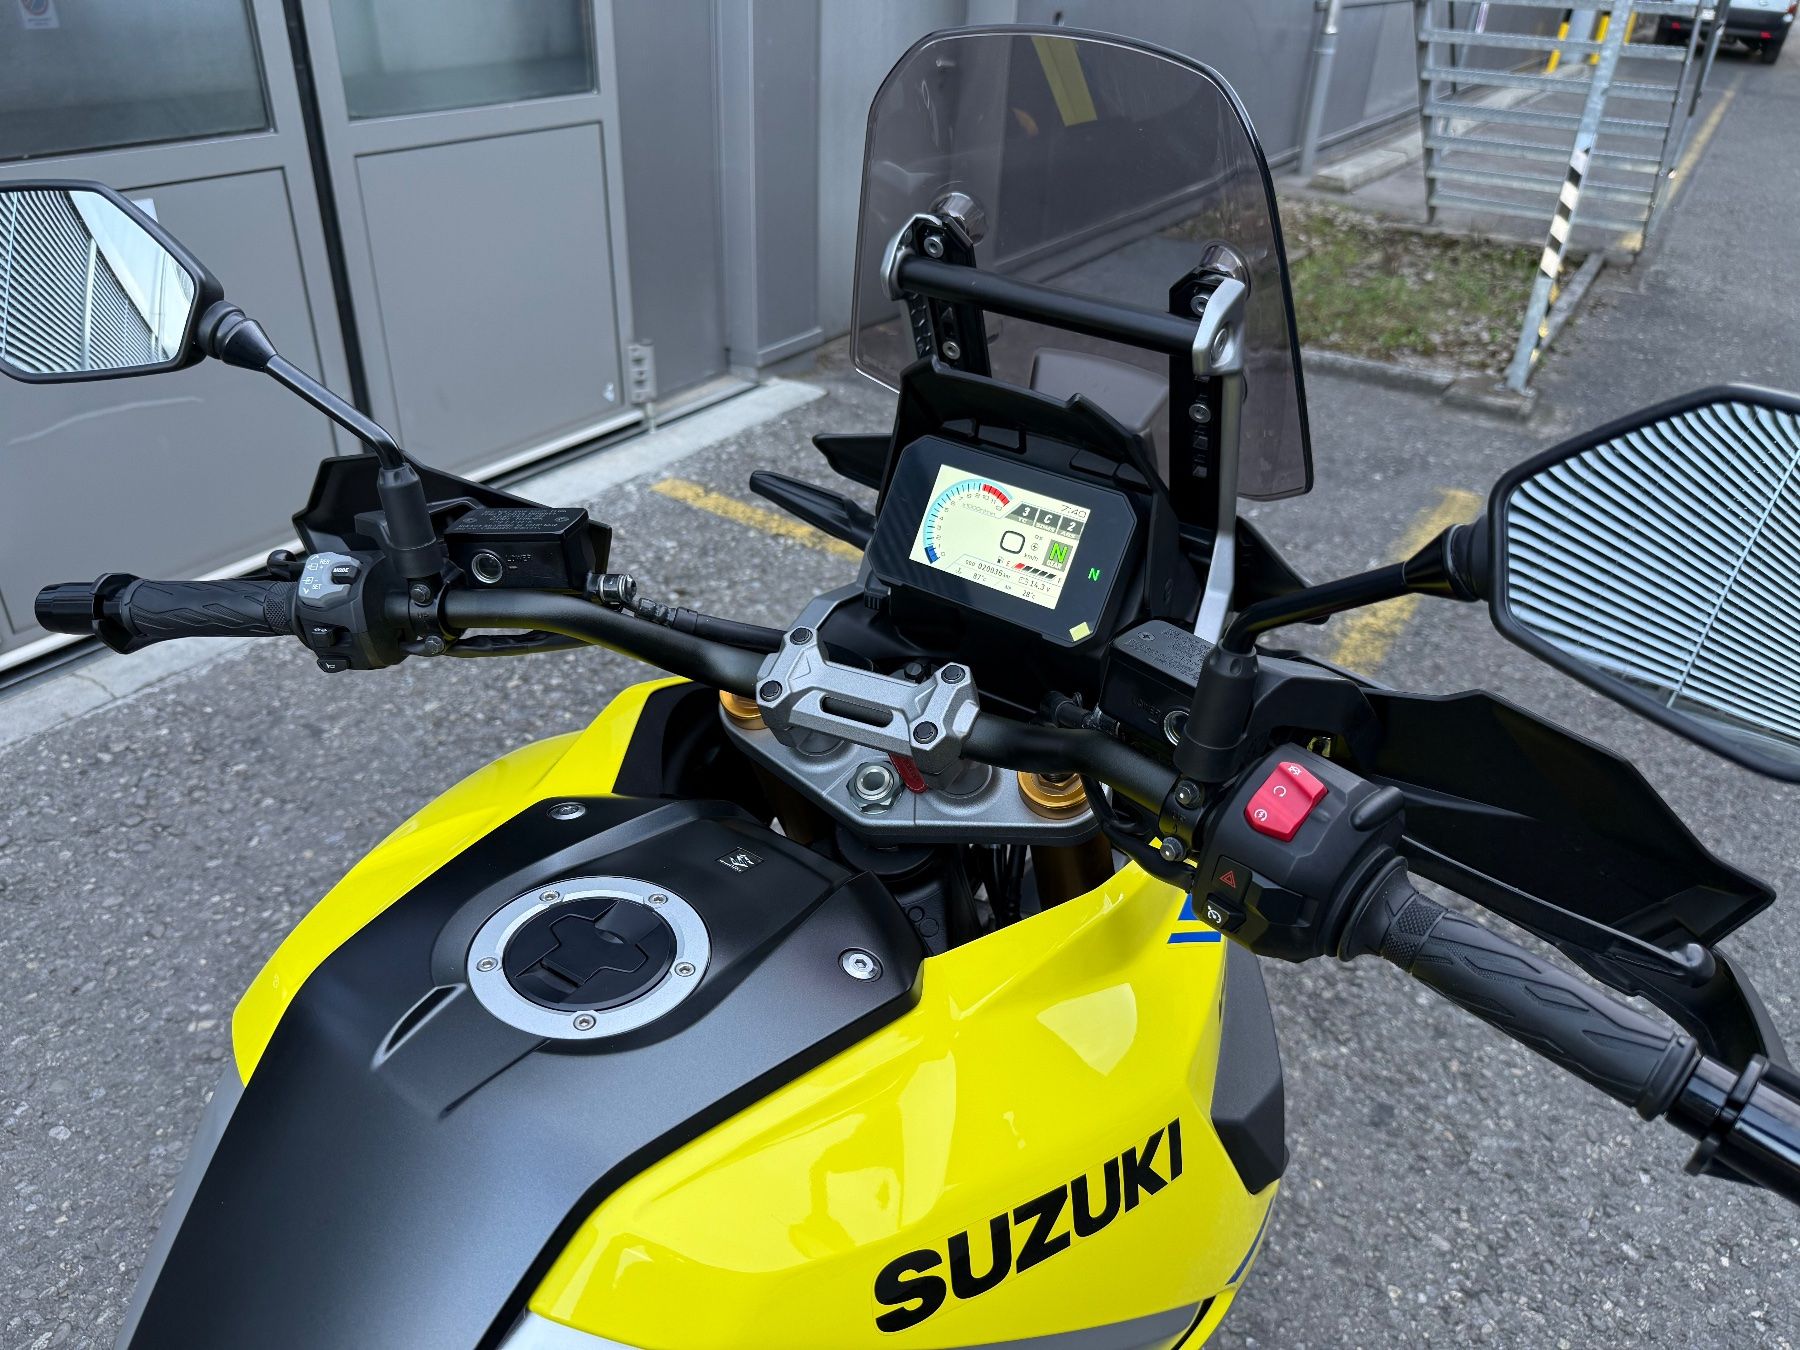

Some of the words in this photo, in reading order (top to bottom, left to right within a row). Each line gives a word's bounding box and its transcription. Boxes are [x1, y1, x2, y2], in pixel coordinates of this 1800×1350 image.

[1022, 507, 1030, 516] 3
[1044, 515, 1053, 524] C
[1067, 522, 1076, 531] 2
[1061, 505, 1087, 518] 7:40
[1049, 542, 1068, 564] N
[1088, 567, 1100, 581] N
[1030, 580, 1045, 591] 14.3
[874, 1117, 1183, 1333] SUZUKI
